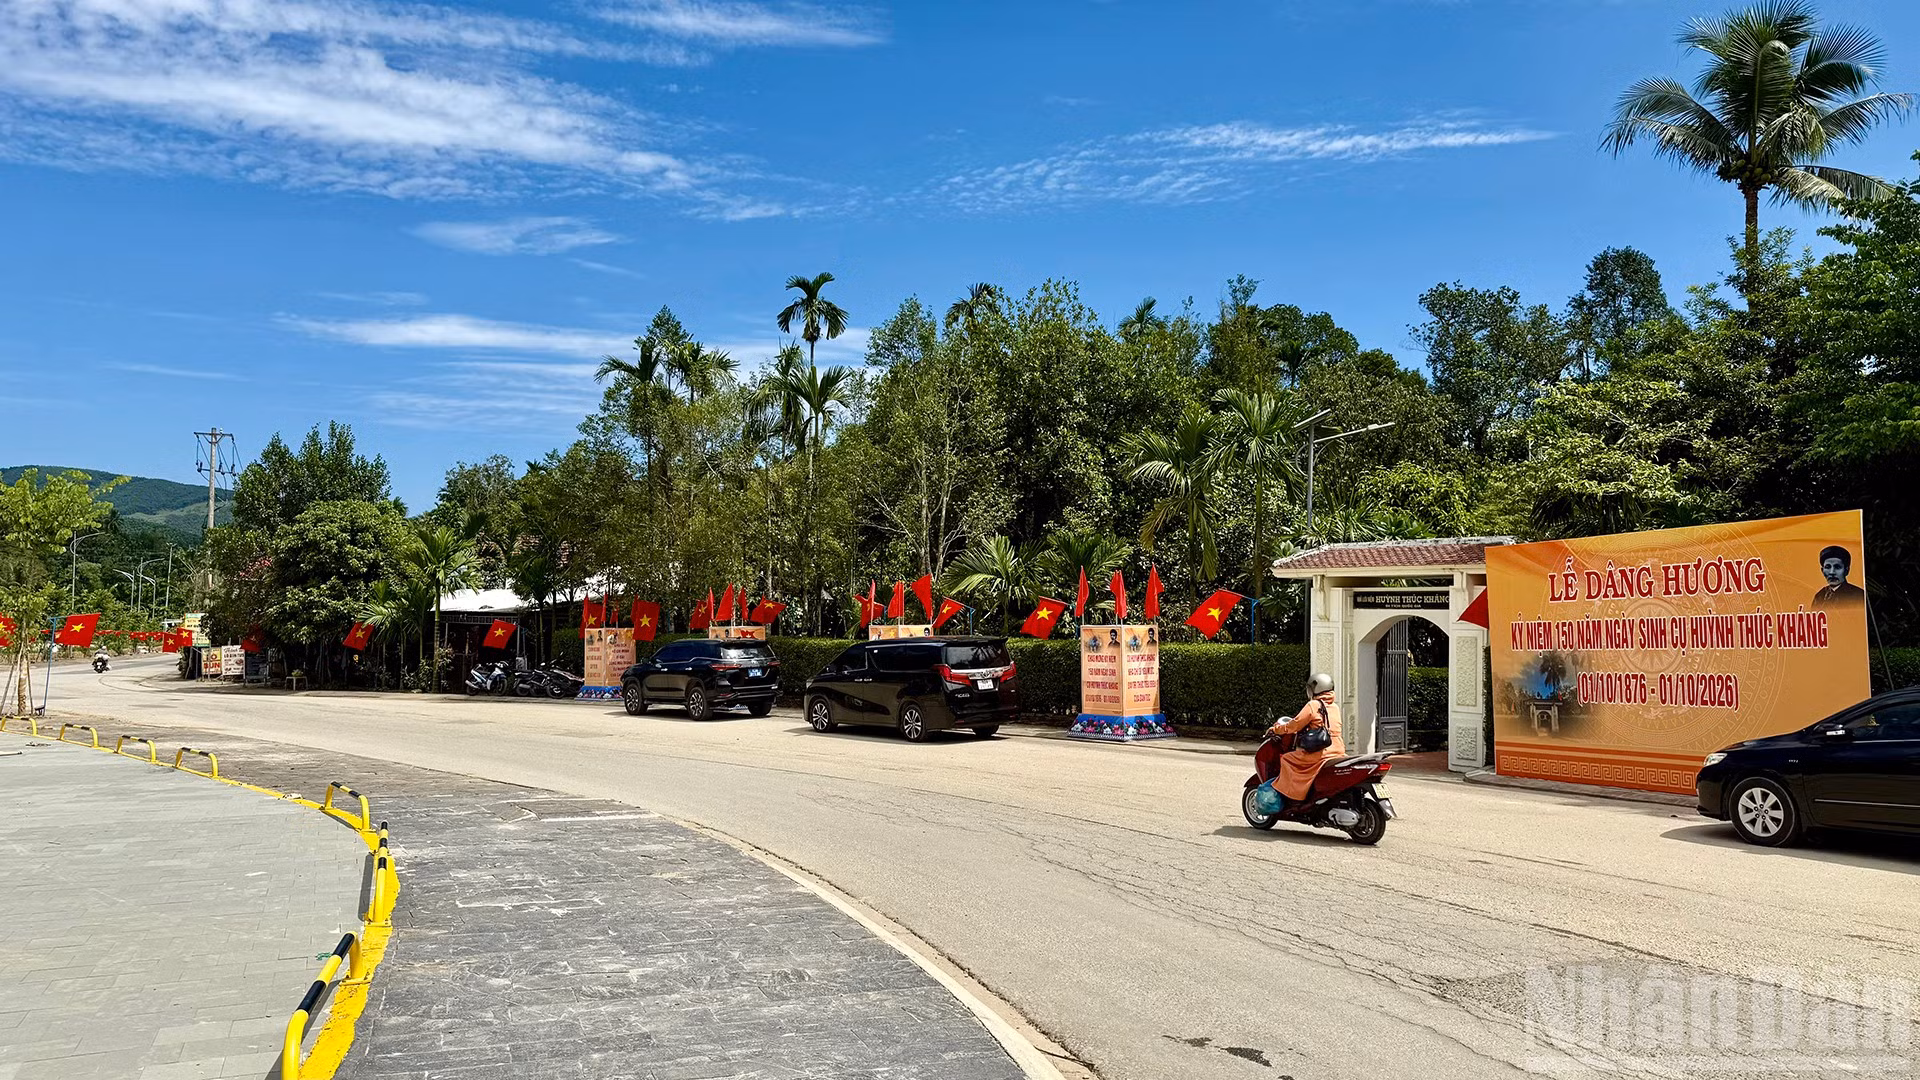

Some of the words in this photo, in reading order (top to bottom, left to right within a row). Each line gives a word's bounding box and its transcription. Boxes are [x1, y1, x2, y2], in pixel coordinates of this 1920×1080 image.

[1375, 594, 1400, 603] HUỲNH
[1401, 594, 1423, 603] THÚC
[1549, 556, 1578, 603] LỄ
[1584, 560, 1654, 600] DÂNG
[1662, 556, 1765, 596] HƯƠNG
[1511, 612, 1524, 650] KỶ
[1526, 615, 1553, 657] NIỆM
[1555, 620, 1574, 650] 150
[1576, 612, 1602, 650] NĂM
[1605, 611, 1635, 650] NGÀY
[1638, 617, 1668, 650] SINH
[1670, 616, 1687, 656] CỤ
[1690, 608, 1734, 649] HUỲNH
[1737, 606, 1773, 649] THÚC
[1777, 604, 1828, 649] KHÁNG
[1577, 672, 1647, 707] (01/10/1876
[1658, 672, 1739, 712] 01/10/2026)
